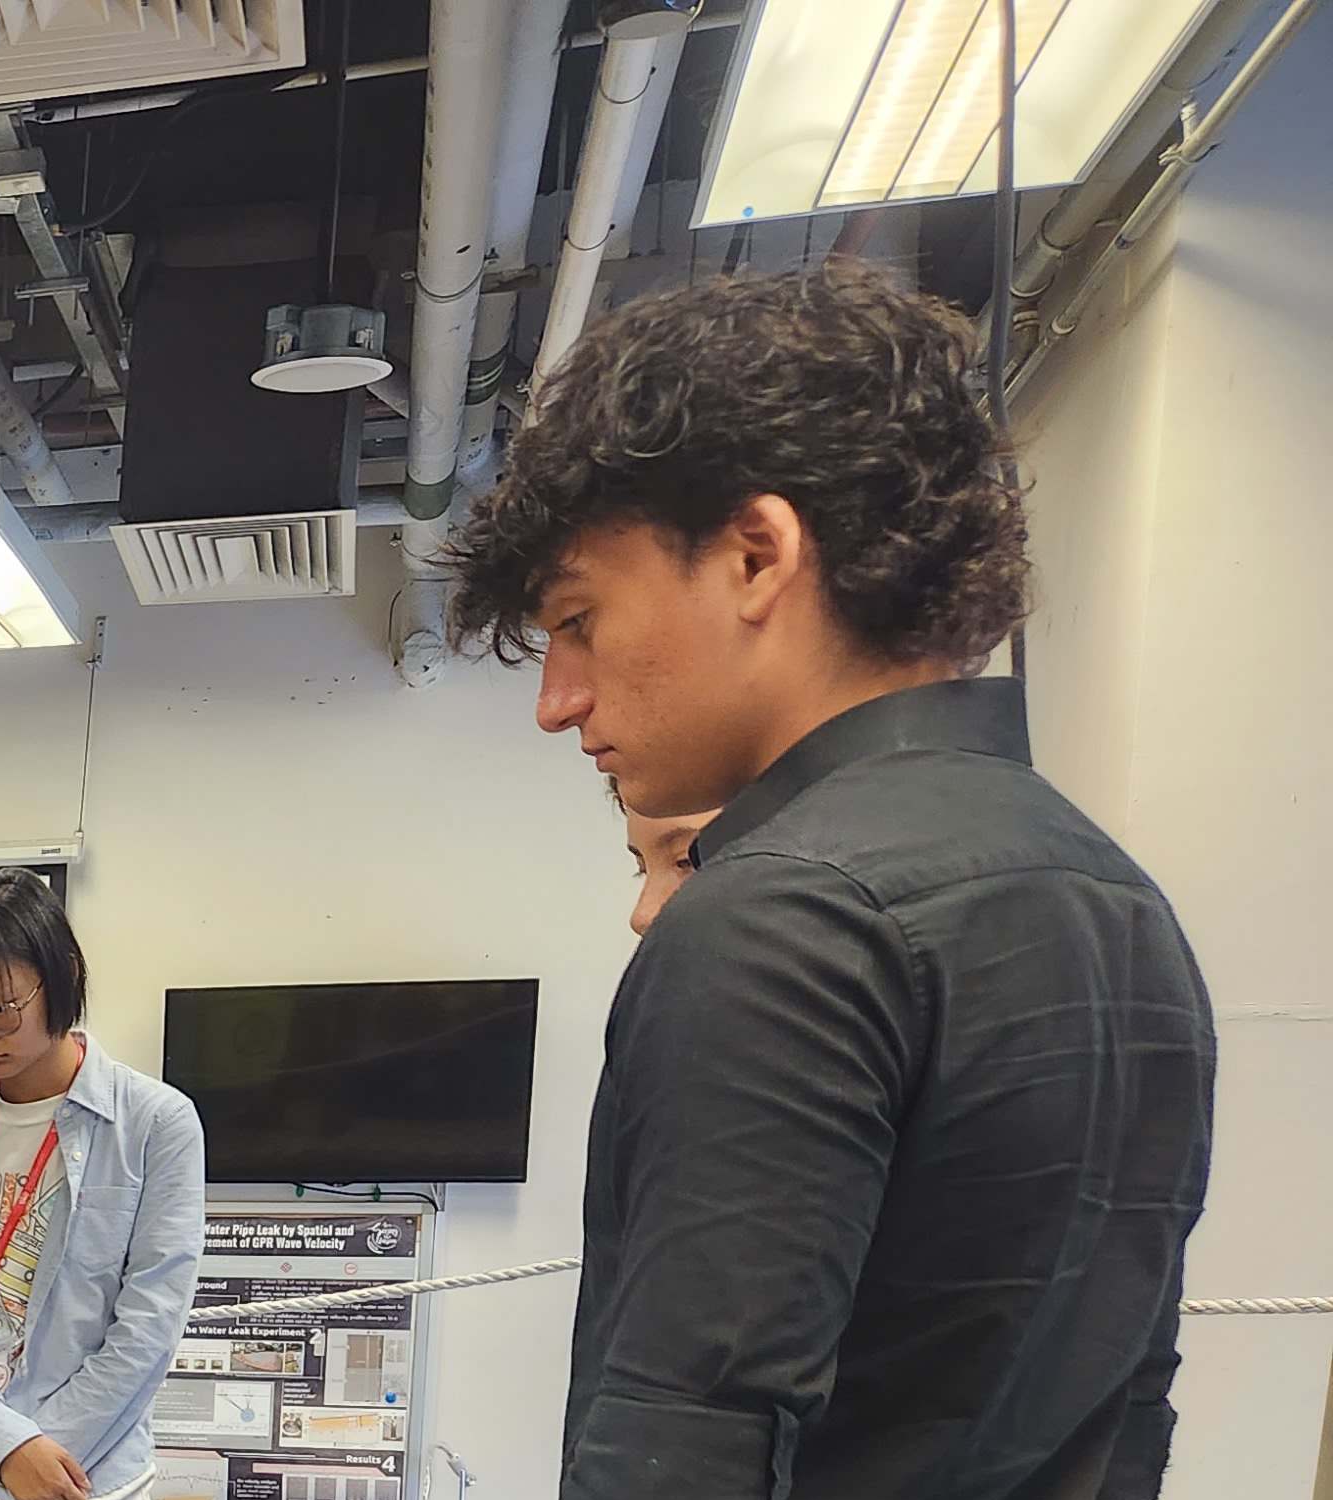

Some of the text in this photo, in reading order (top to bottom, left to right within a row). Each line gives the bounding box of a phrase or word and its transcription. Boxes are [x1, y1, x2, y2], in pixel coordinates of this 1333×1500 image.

[232, 1225, 255, 1237] Pipe
[257, 1225, 280, 1236] Leak
[283, 1224, 295, 1238] by
[297, 1224, 333, 1238] Spatial
[335, 1225, 355, 1236] and
[203, 1237, 346, 1251] rement of GPR Wave Velocity
[195, 1282, 227, 1291] ground
[185, 1326, 306, 1338] he Water Leak Experiment
[310, 1328, 323, 1344] 2
[346, 1455, 382, 1464] Results
[382, 1455, 396, 1472] 4
